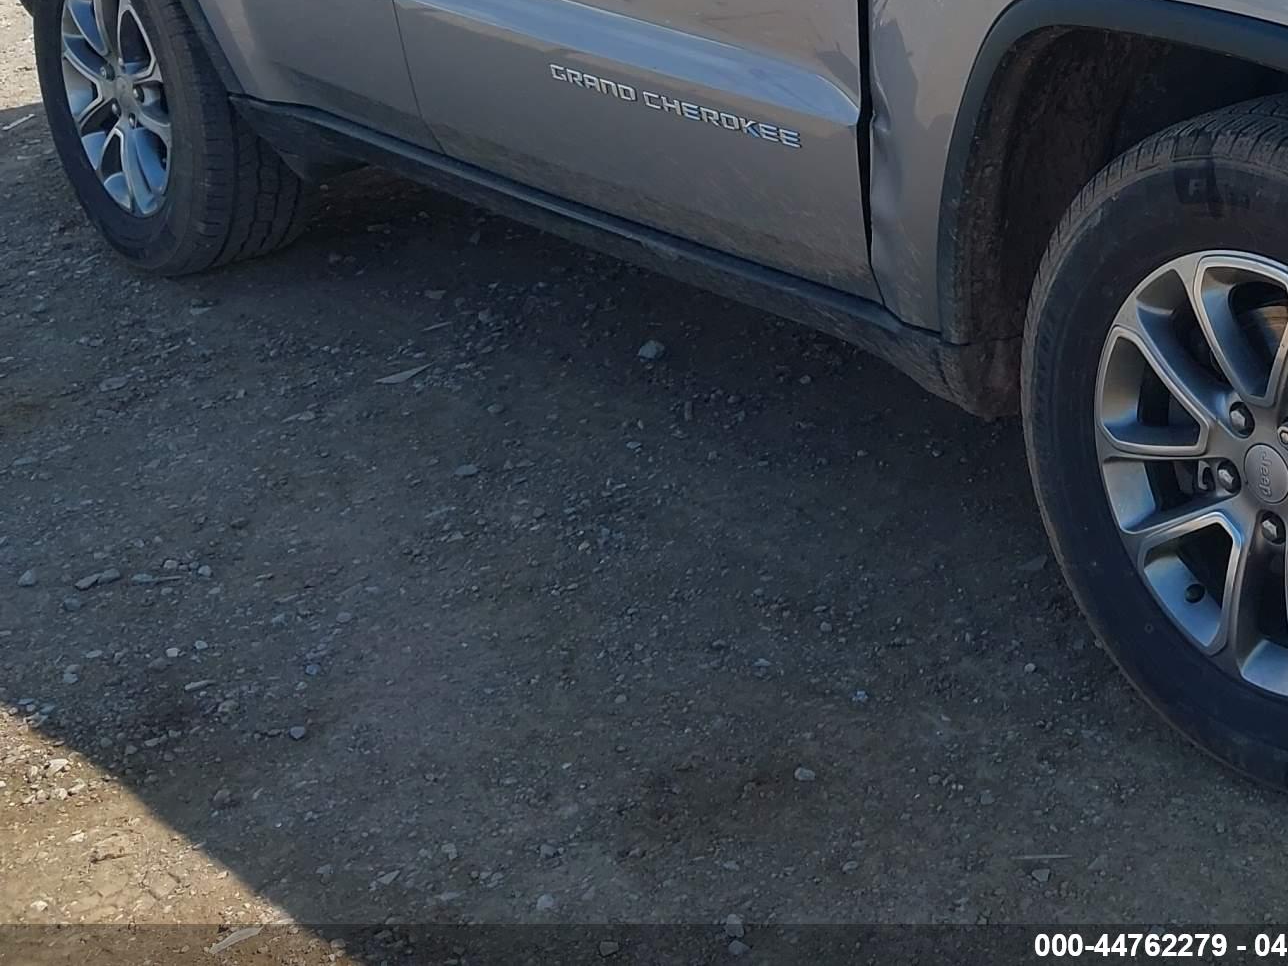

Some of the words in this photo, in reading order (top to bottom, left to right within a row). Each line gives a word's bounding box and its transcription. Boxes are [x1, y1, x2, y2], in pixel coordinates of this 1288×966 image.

[549, 64, 637, 102] GRAND
[642, 90, 802, 149] CHEROKEE
[1259, 450, 1273, 498] Jeep
